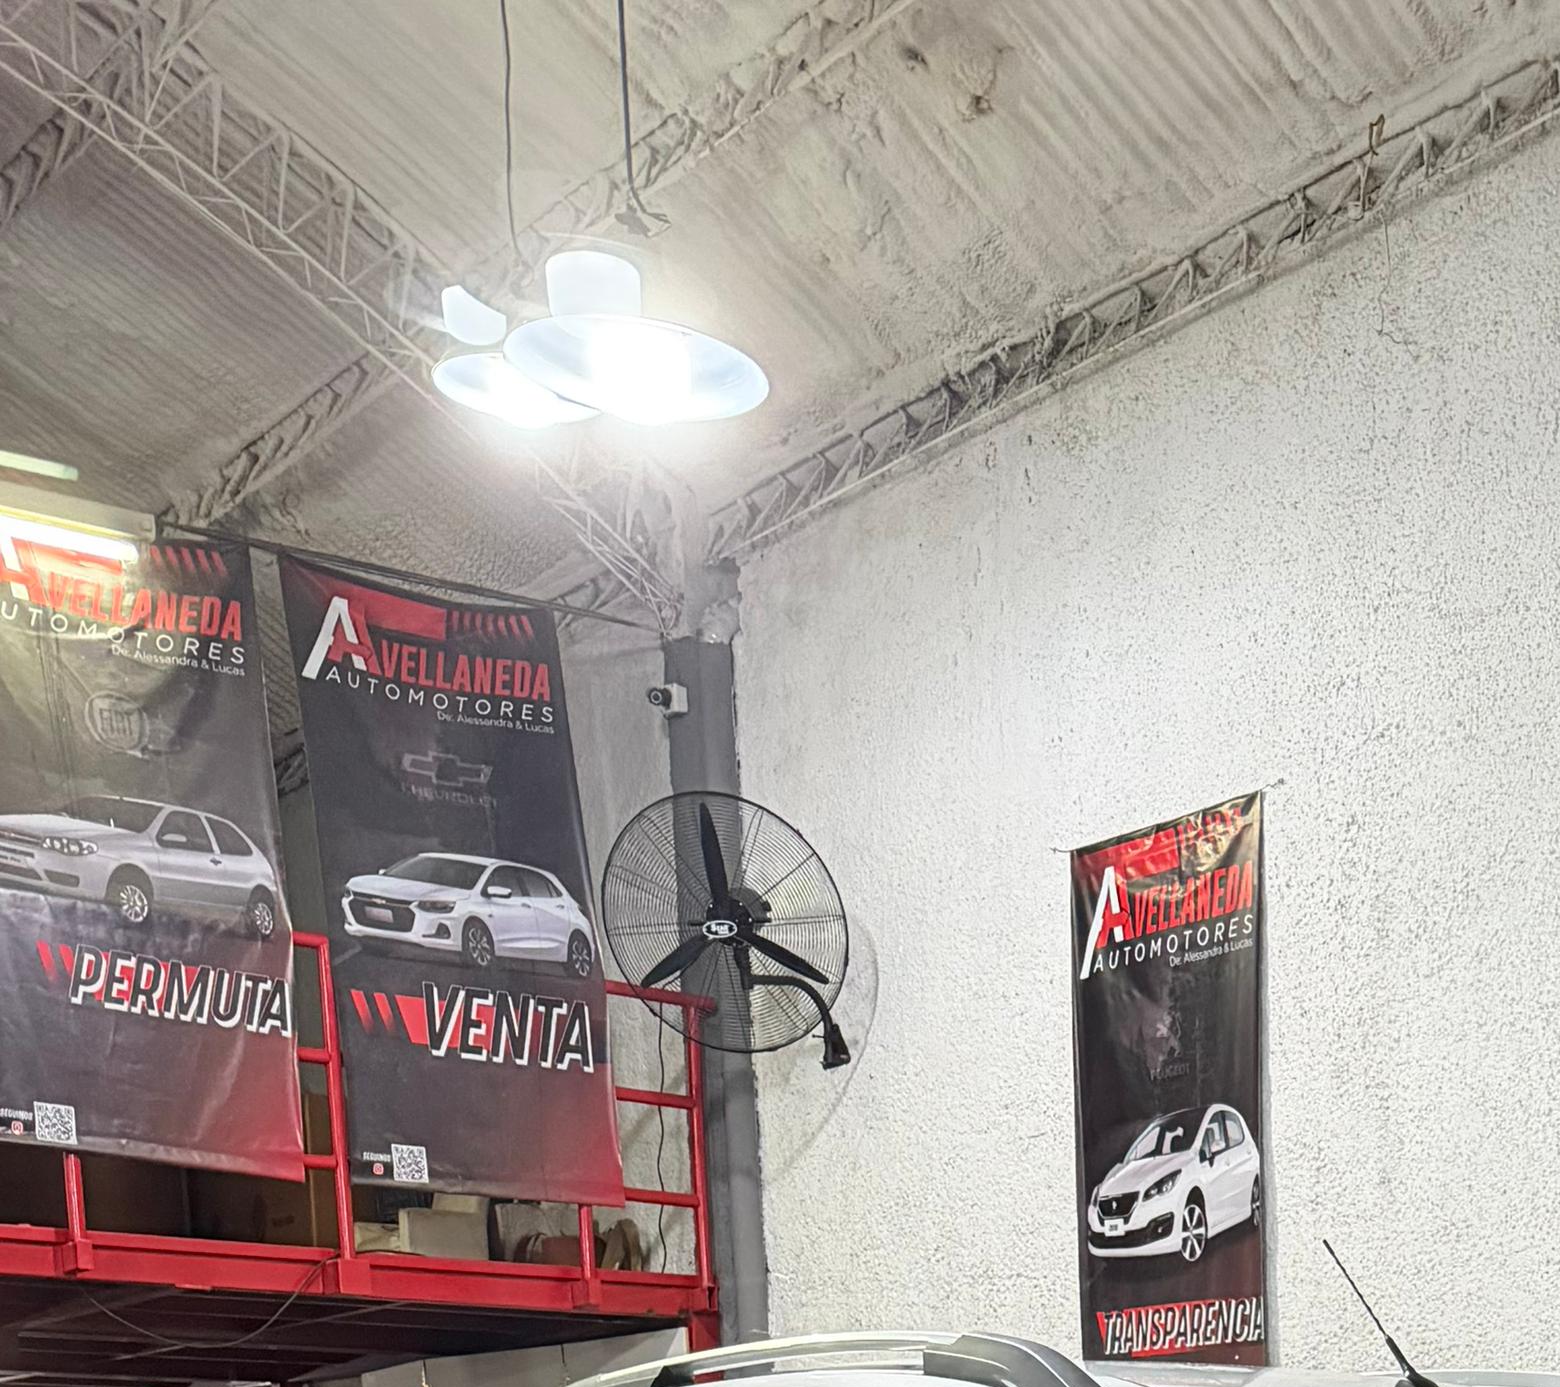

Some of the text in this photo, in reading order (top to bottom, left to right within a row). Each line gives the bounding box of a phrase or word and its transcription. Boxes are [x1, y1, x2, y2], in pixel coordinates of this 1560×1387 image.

[1, 600, 245, 664] UTOMOTORES
[301, 595, 551, 702] AVELLANEDA
[212, 661, 245, 676] Lucas
[325, 665, 553, 722] AUTOMOTORES
[525, 722, 554, 734] Lucas
[1079, 860, 1253, 980] AVELLANEDA
[1093, 914, 1253, 974] AUTOMOTORES
[69, 943, 292, 1038] PERMUTA
[422, 981, 594, 1074] VENTA
[1103, 1297, 1265, 1355] TRANSPARENCIA
